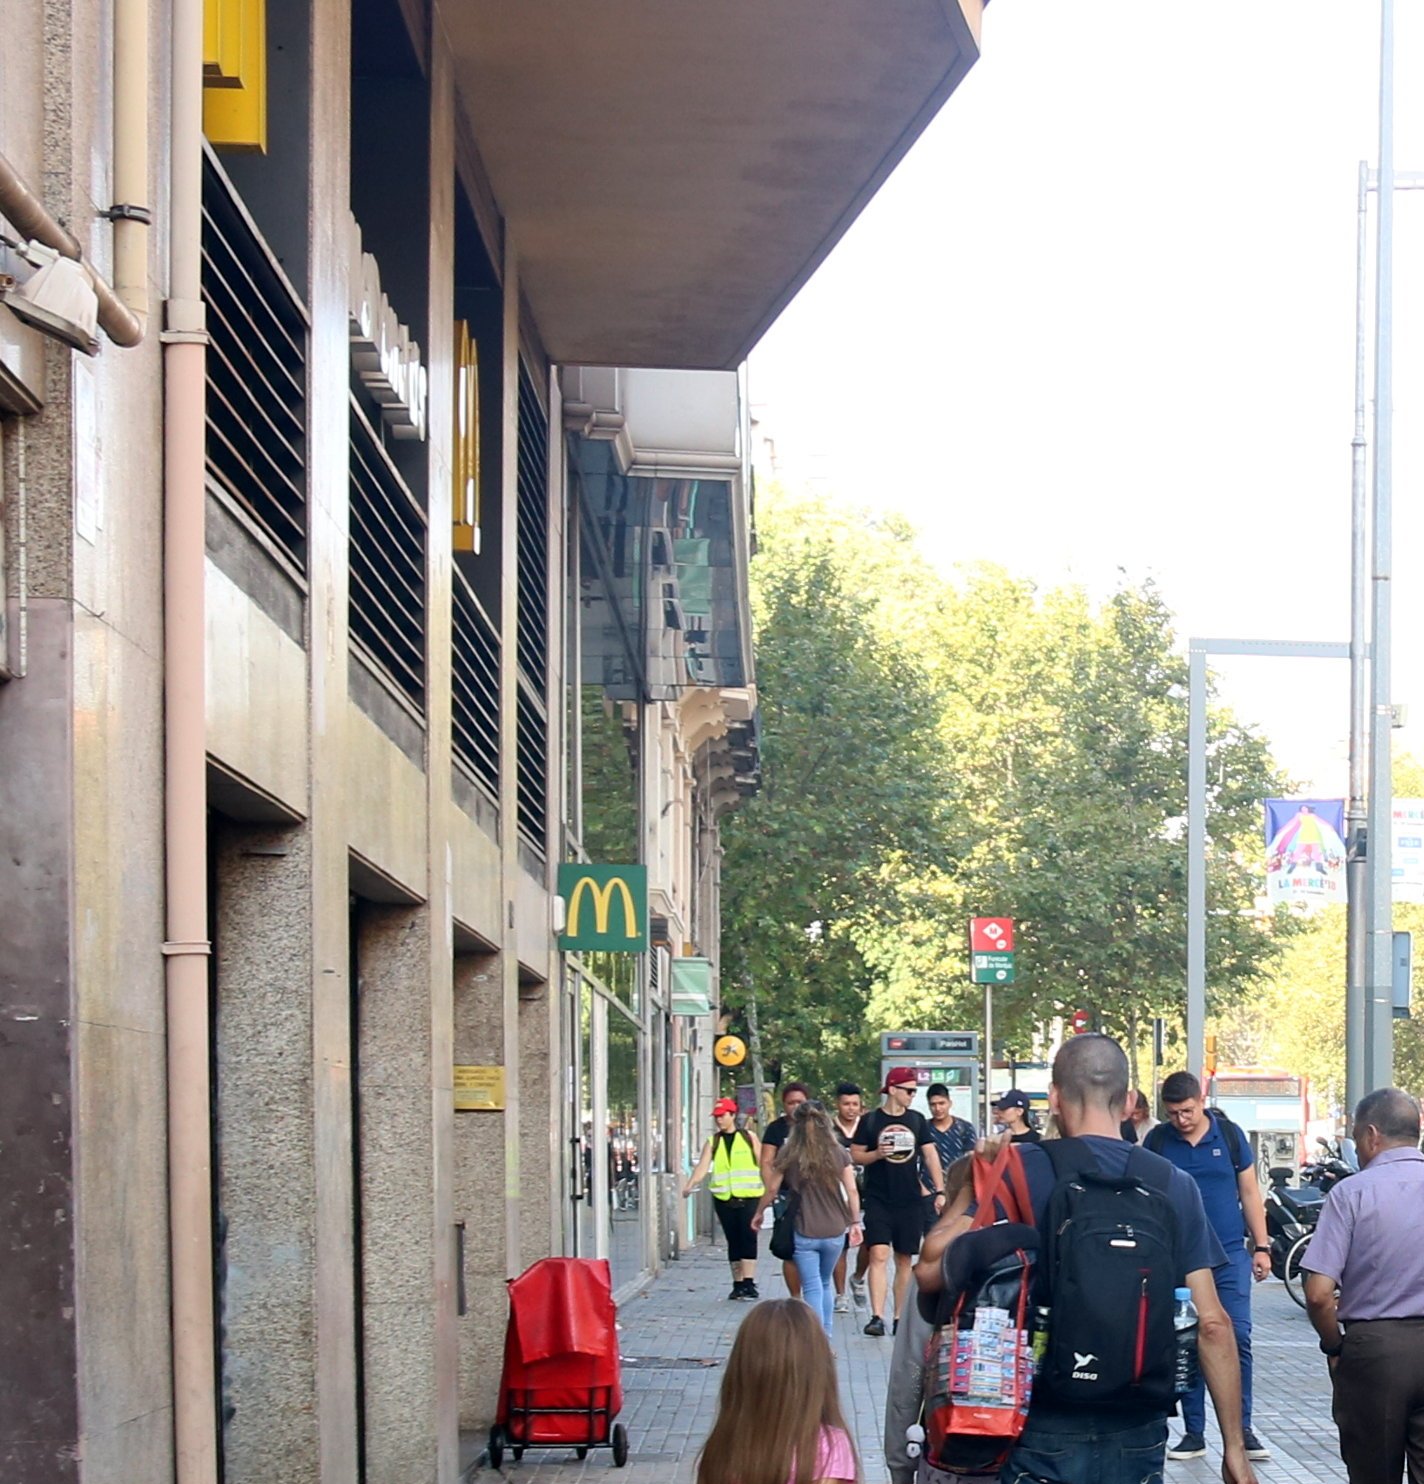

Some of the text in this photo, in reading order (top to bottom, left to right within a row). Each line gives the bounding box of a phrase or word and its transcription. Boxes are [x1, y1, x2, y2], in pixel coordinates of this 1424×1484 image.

[1278, 878, 1290, 889] LA
[917, 1072, 944, 1081] L2 L3
